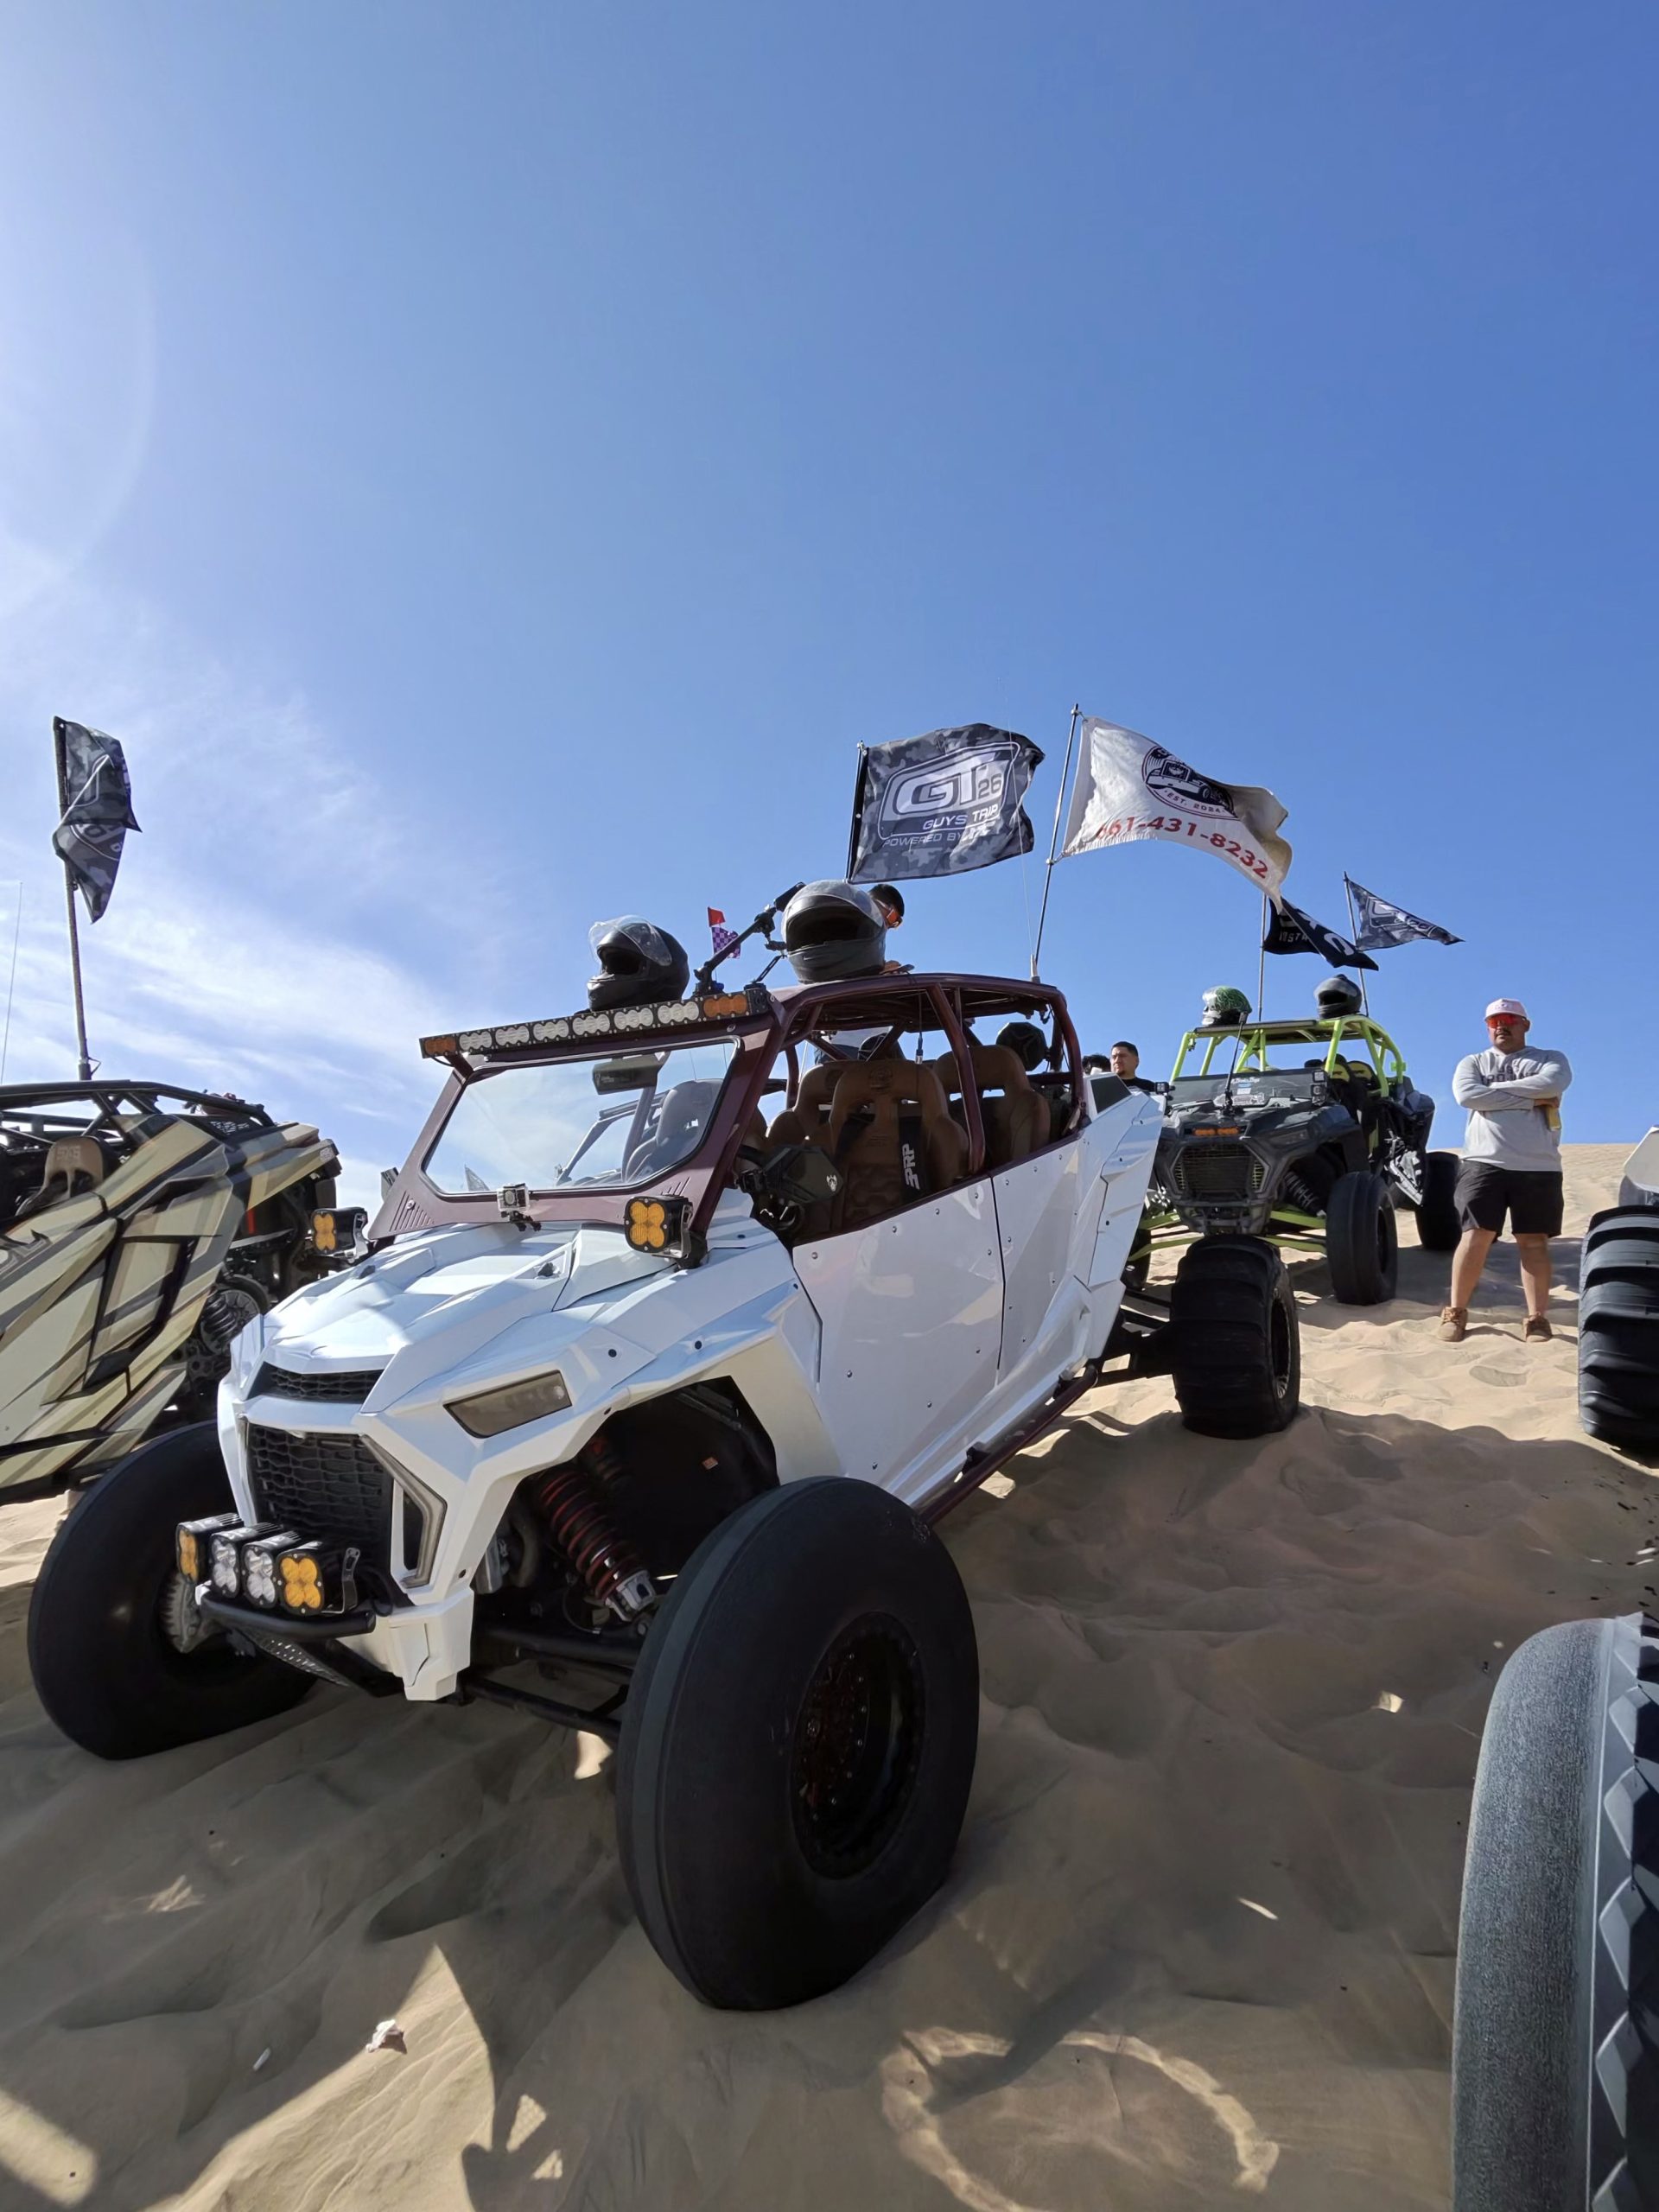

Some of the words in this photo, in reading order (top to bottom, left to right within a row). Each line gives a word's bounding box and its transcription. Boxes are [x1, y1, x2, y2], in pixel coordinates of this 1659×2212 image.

[893, 752, 997, 813] GT
[977, 772, 1002, 798] 26
[1166, 791, 1187, 806] EST.
[1192, 803, 1221, 813] 2024
[922, 814, 968, 830] GUYS
[972, 804, 998, 823] TRIP
[883, 832, 942, 848] POWERED
[947, 832, 962, 842] BY
